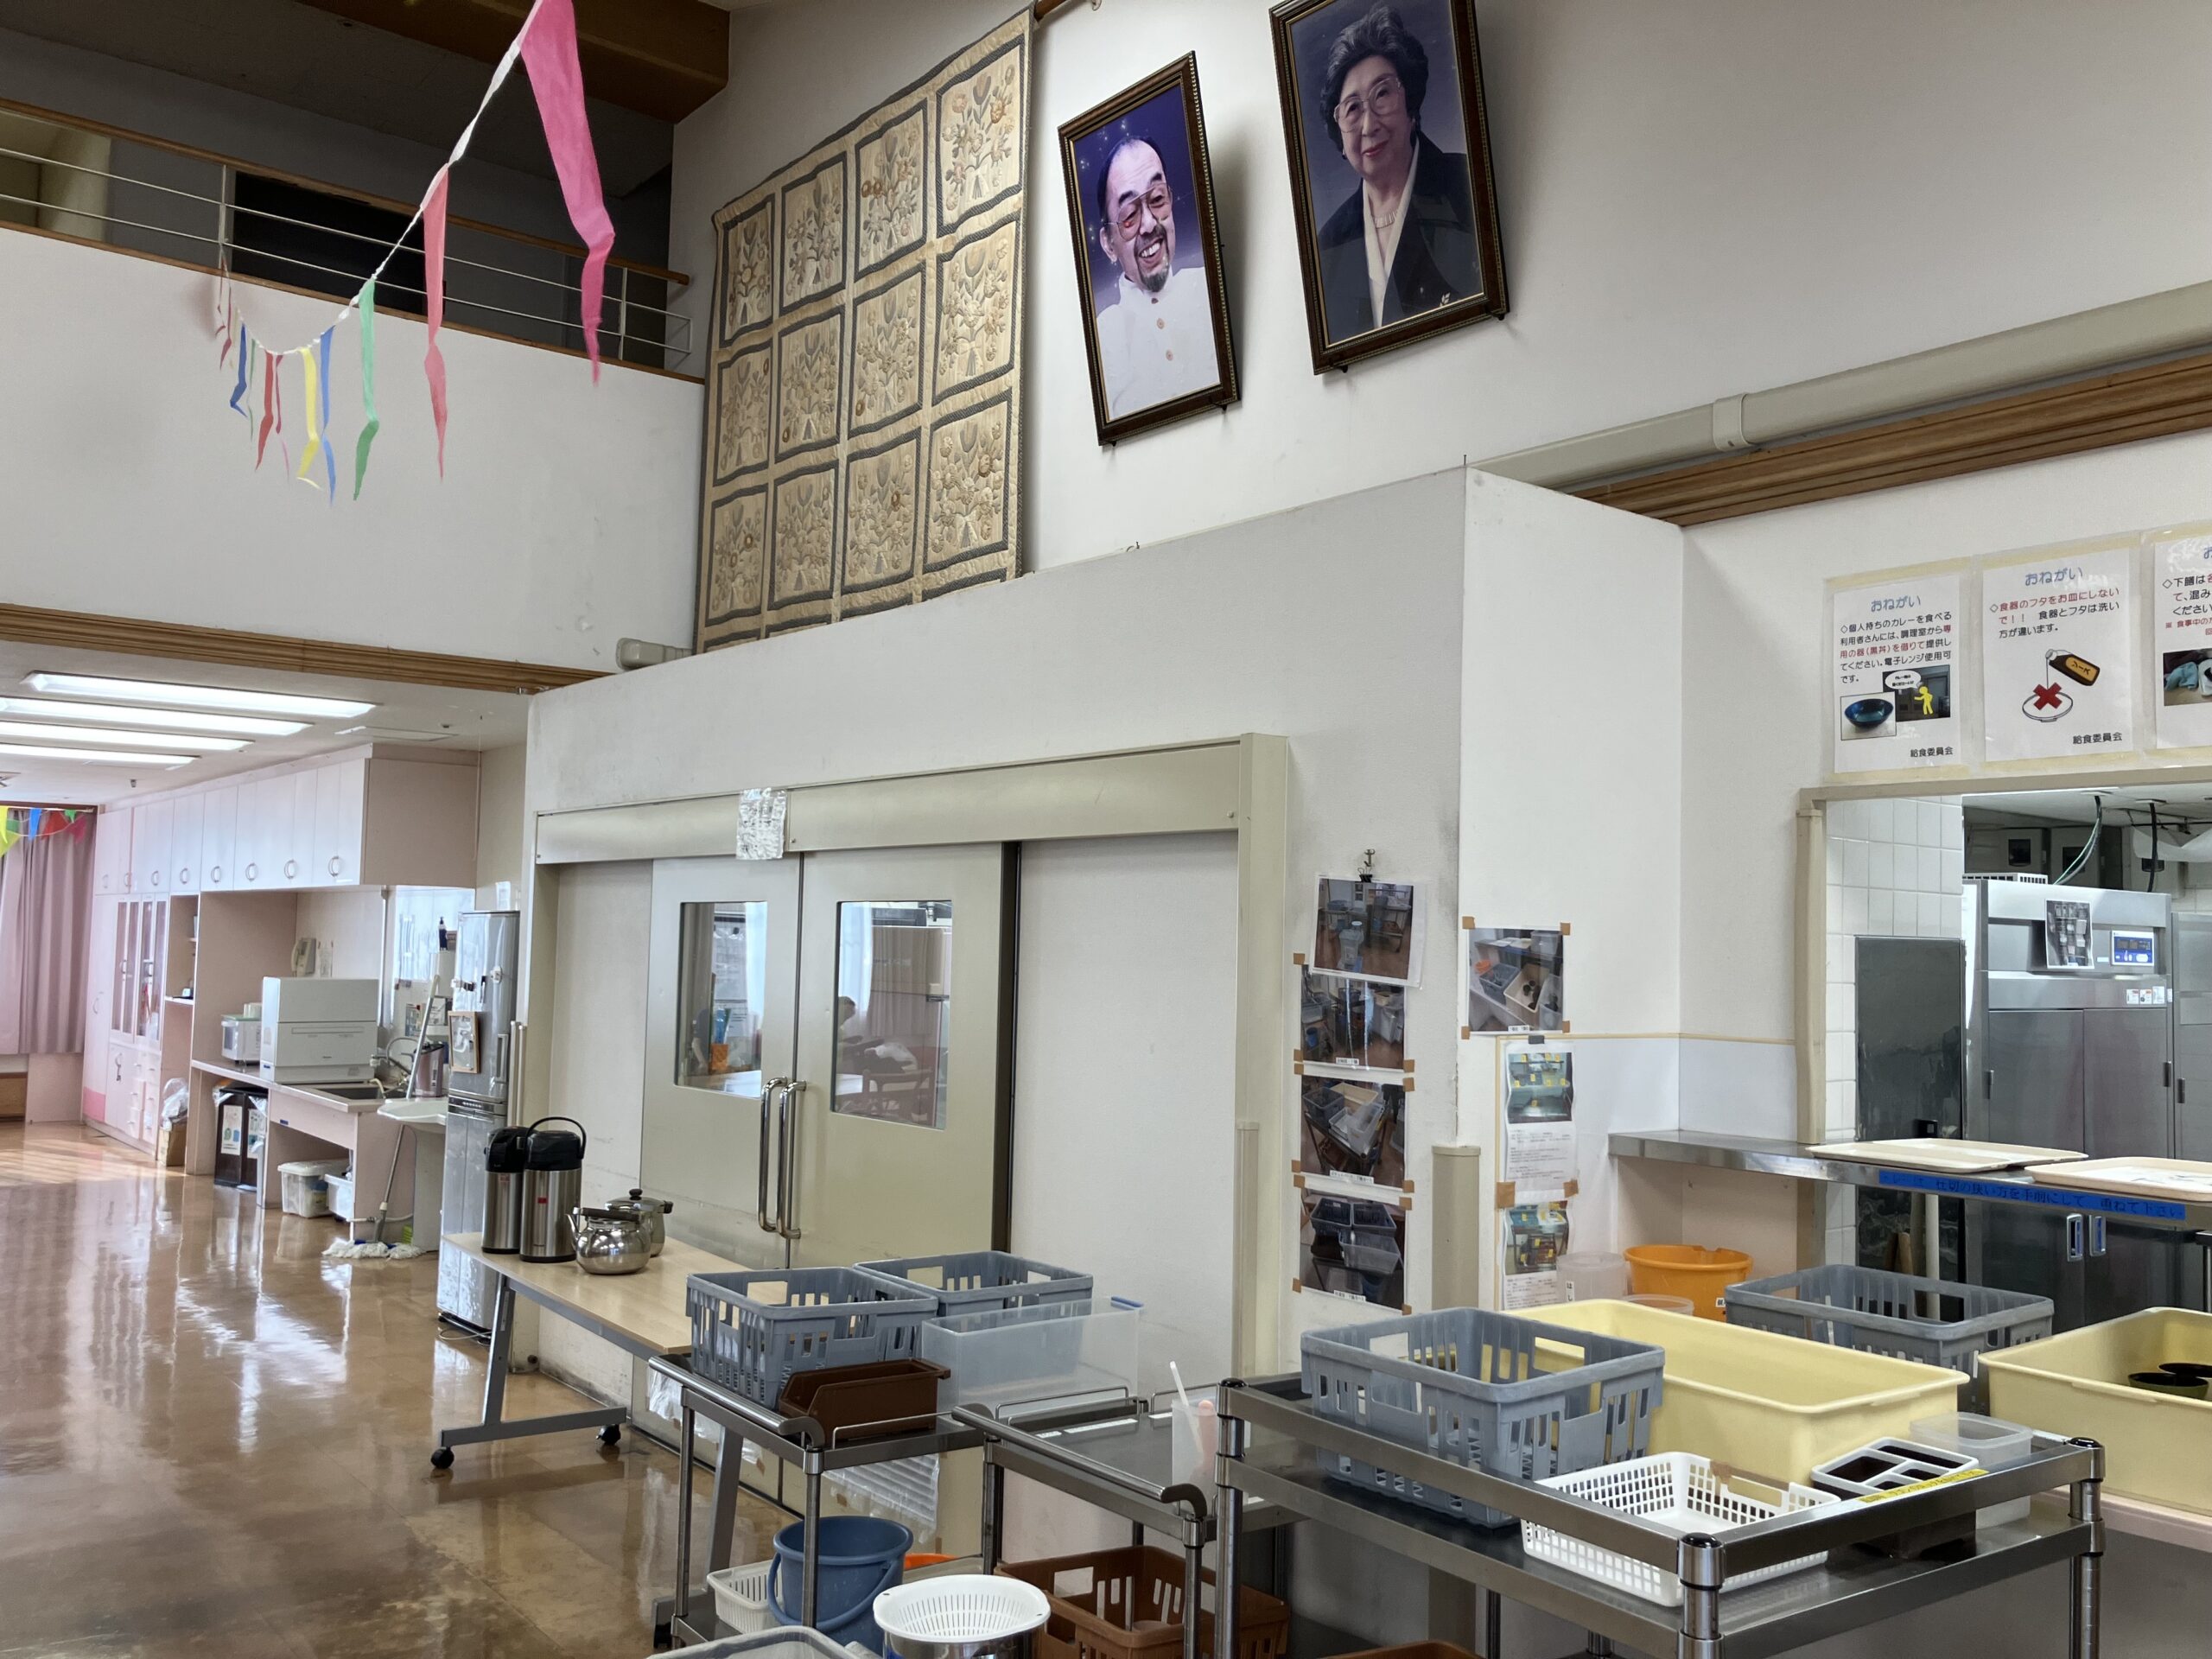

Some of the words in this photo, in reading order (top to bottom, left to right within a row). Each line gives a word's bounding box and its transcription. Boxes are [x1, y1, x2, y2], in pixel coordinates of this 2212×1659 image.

[2025, 567, 2083, 586] おねがい
[1871, 595, 1921, 613] おねがい
[1999, 588, 2120, 612] 食器のフタをお皿にしない
[2039, 601, 2120, 620] 食器とフタは洗い
[1999, 624, 2059, 639] 方が違います。
[1910, 746, 1954, 758] 給食委員会
